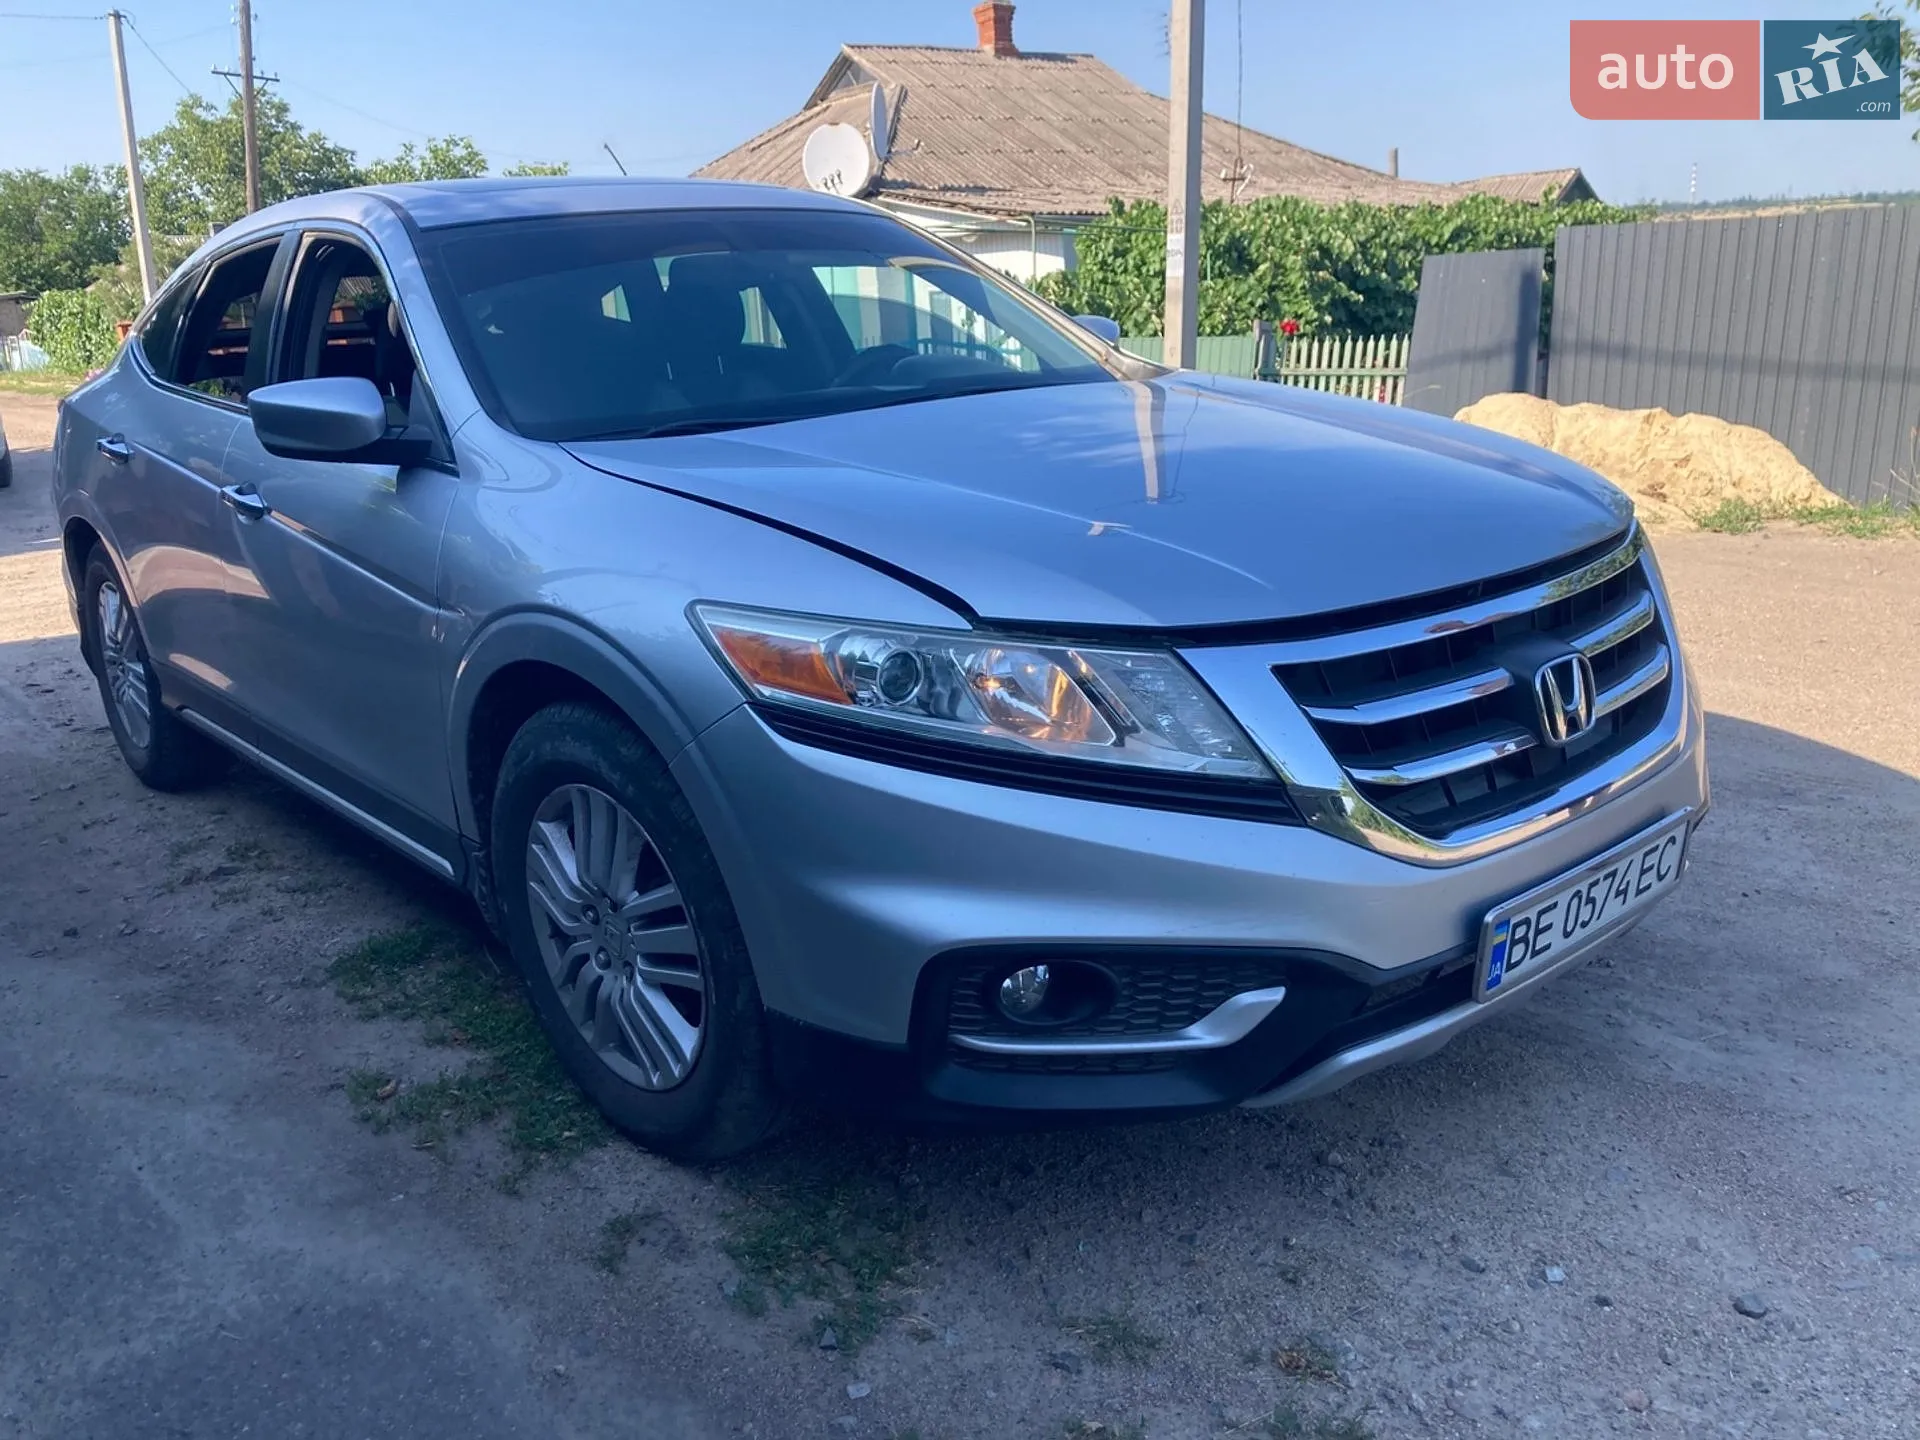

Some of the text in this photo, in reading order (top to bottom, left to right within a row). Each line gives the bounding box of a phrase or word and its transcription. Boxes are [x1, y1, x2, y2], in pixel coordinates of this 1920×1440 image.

[1504, 835, 1676, 973] BE 0574 EC
